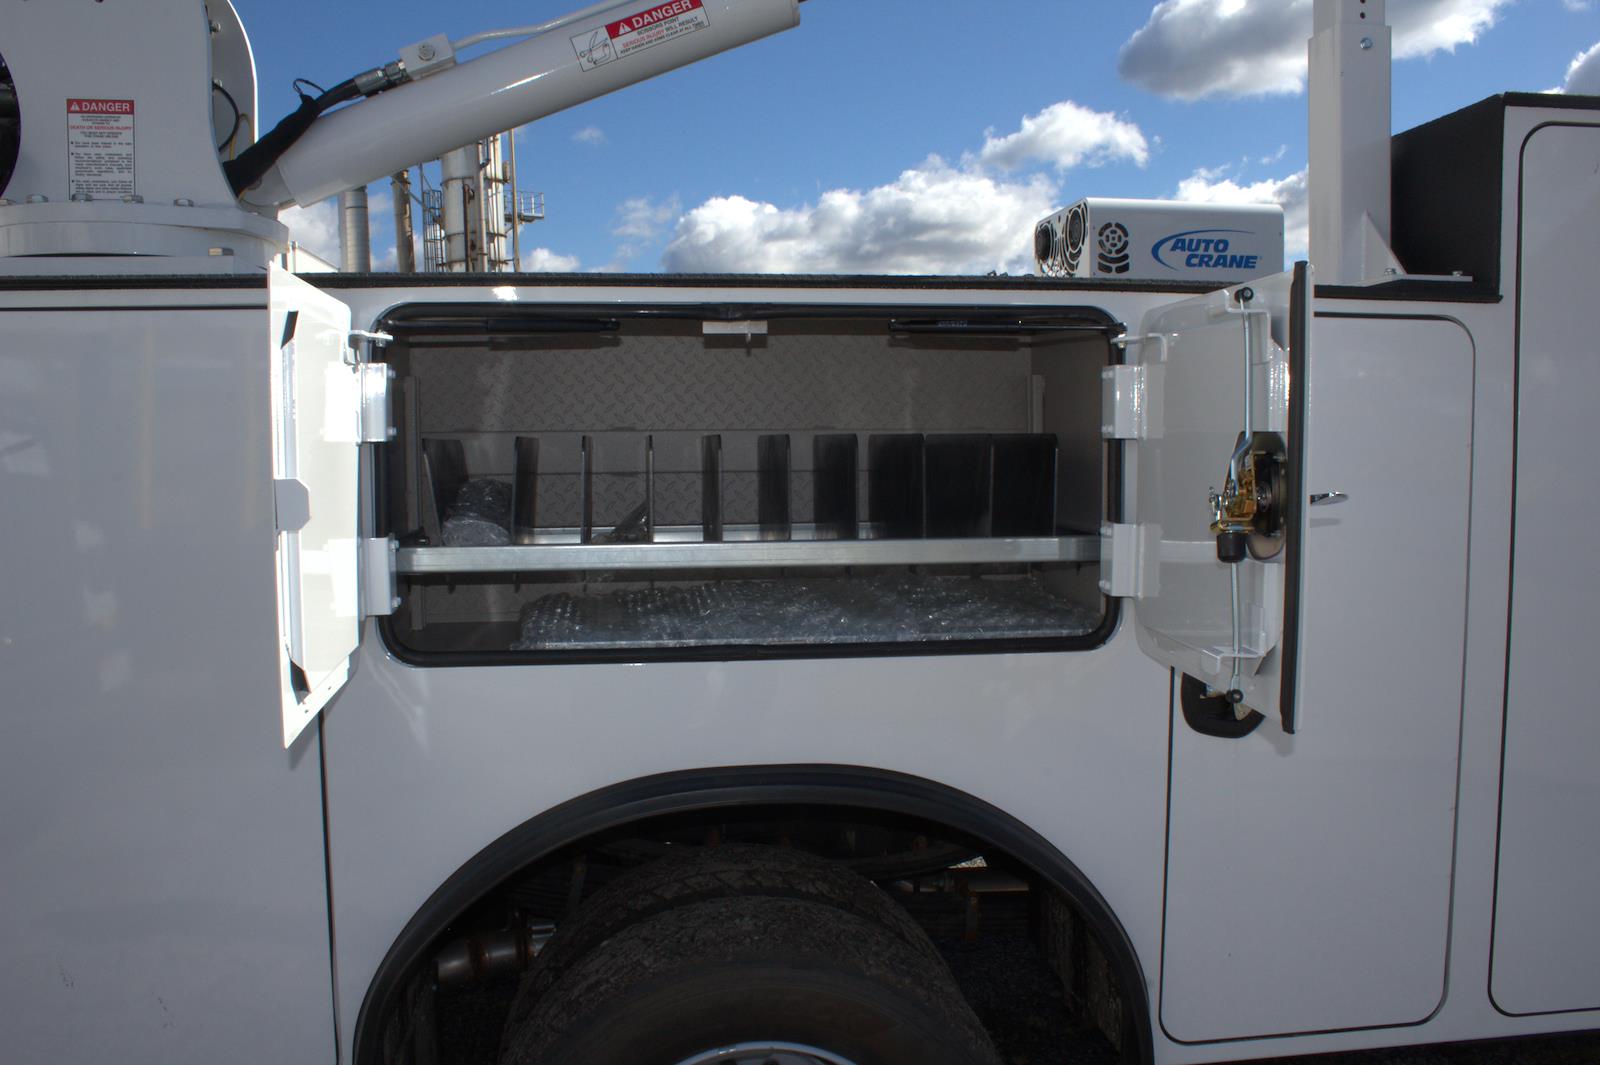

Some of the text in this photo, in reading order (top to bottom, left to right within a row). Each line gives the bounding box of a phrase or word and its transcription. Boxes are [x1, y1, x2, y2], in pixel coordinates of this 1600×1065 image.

[632, 0, 692, 28] DANGER
[664, 17, 679, 25] POINT
[622, 16, 698, 49] SERIOUS INJURY WILL RESULT
[82, 102, 130, 112] DANGER
[1169, 238, 1229, 253] AUTO
[1185, 253, 1257, 269] CRANE
